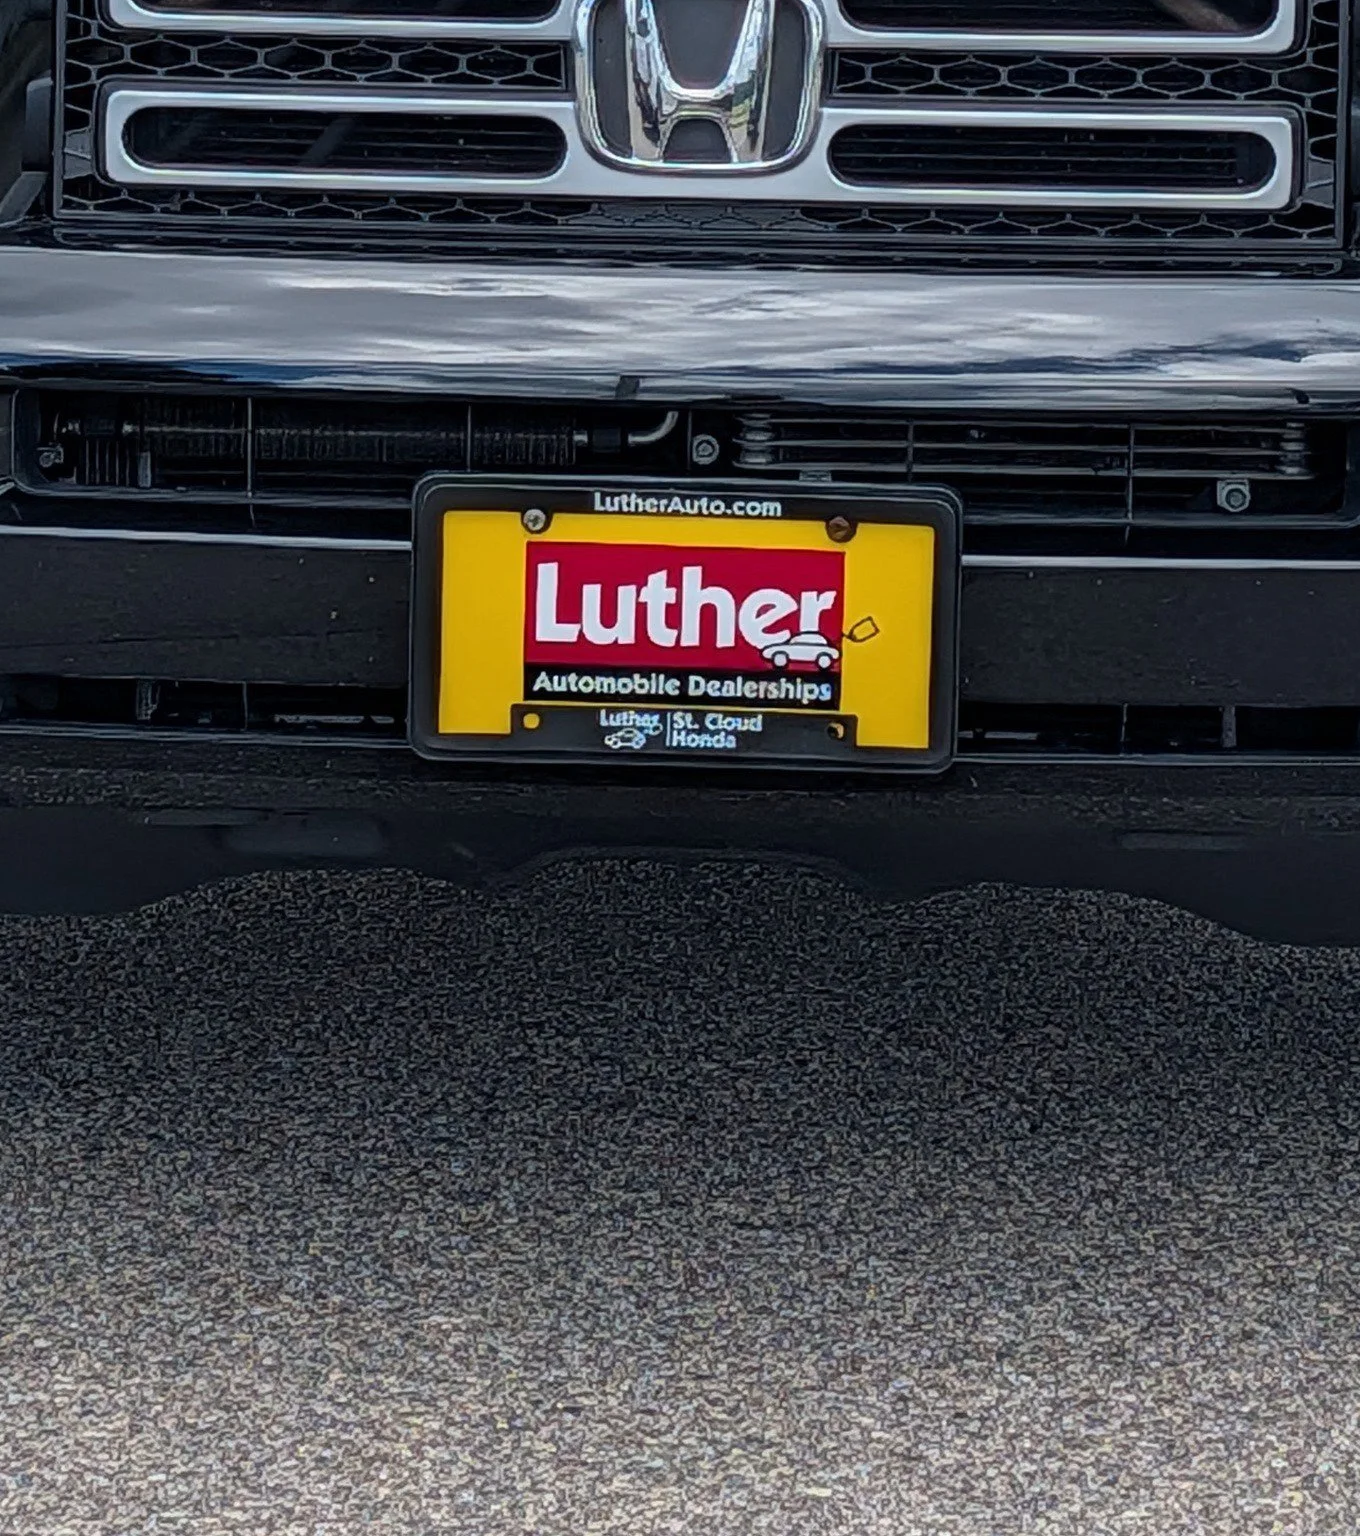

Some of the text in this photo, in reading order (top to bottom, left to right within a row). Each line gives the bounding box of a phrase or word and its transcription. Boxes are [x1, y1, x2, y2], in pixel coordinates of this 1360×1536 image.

[593, 491, 782, 517] LutherAuto.com
[535, 561, 838, 650] Luther
[532, 671, 833, 704] Automobile Dealerships
[672, 712, 763, 732] St. Cloud
[672, 730, 737, 748] Honda
